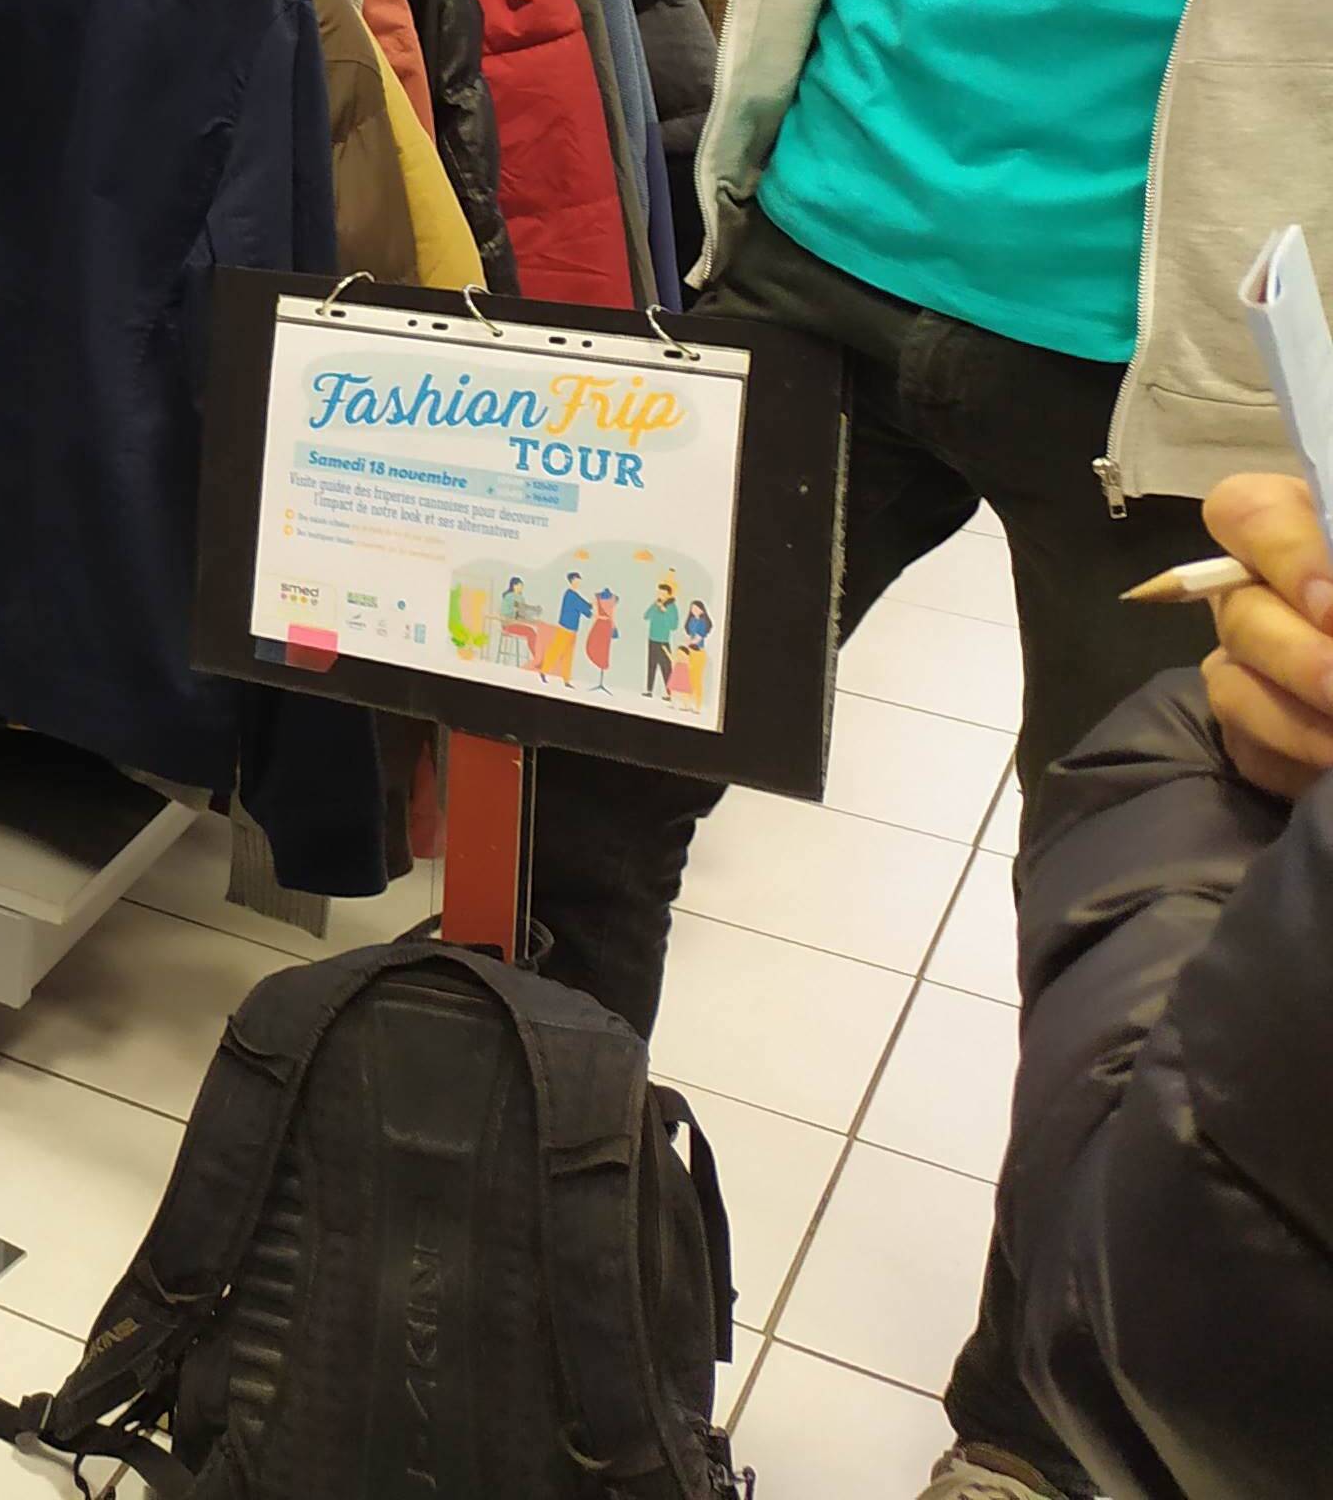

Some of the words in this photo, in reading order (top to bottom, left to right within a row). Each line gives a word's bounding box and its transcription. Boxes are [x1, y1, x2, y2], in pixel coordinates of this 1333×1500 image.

[309, 372, 548, 428] Fashion
[308, 450, 367, 473] Samedi
[369, 460, 386, 476] 18
[388, 466, 468, 489] novembre
[509, 436, 644, 489] TOUR
[371, 503, 398, 520] notre
[280, 582, 319, 598] smed
